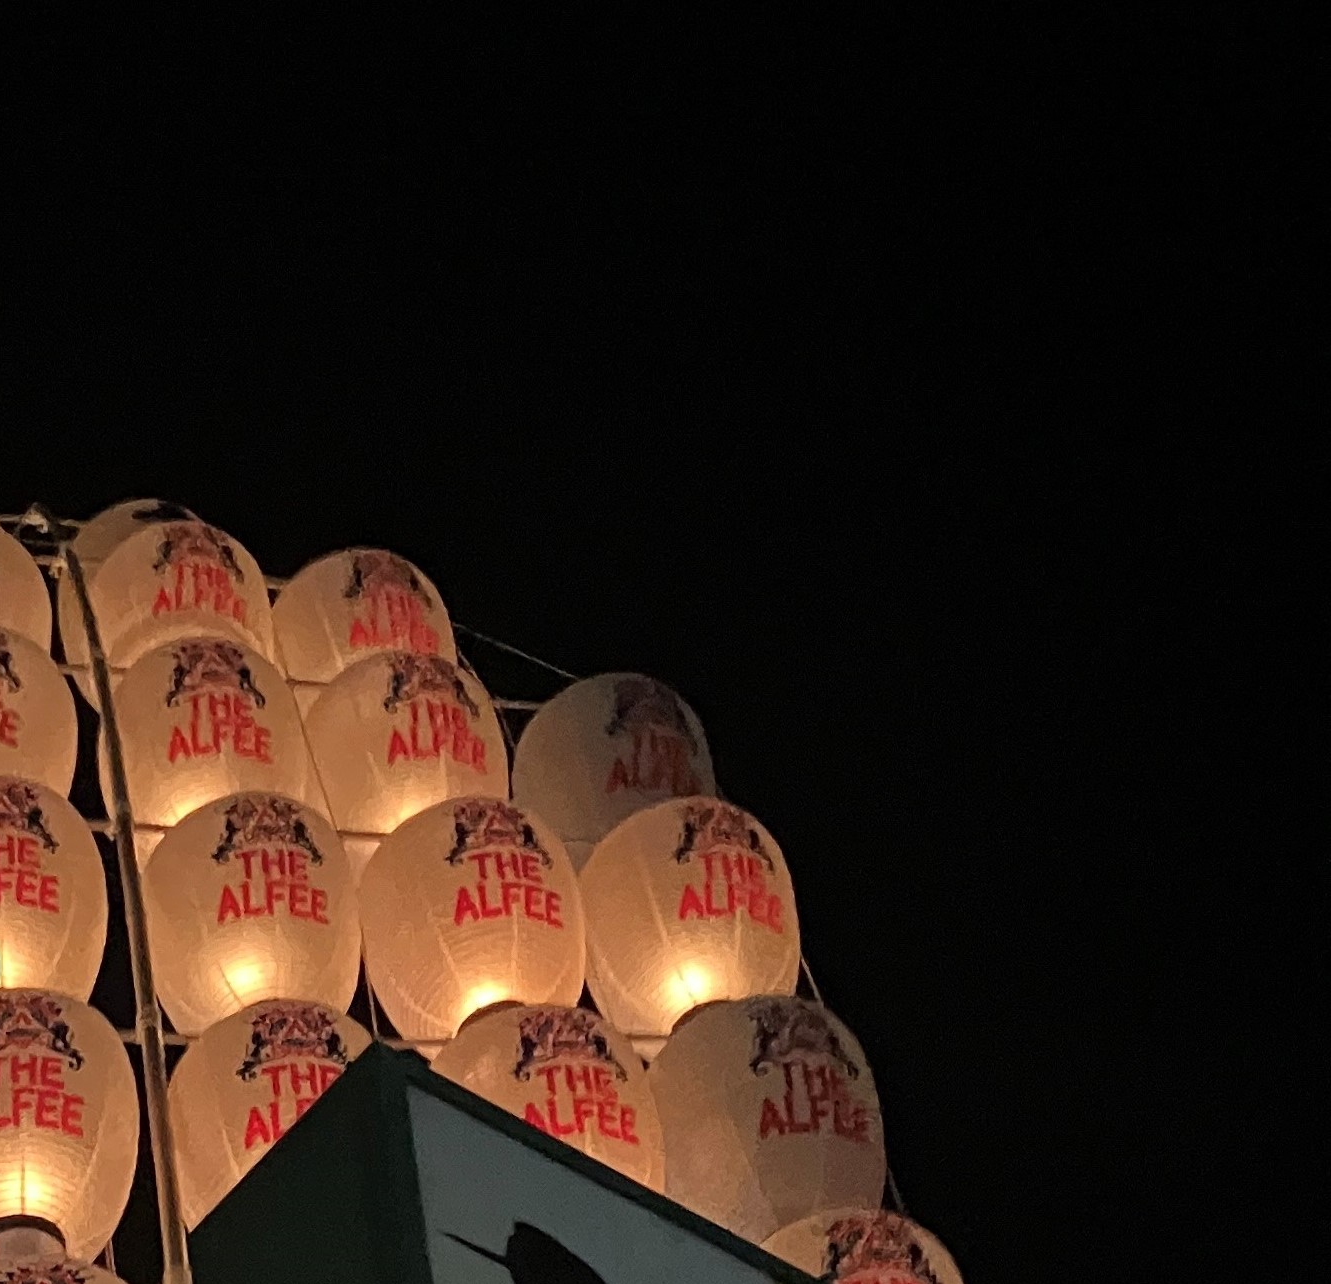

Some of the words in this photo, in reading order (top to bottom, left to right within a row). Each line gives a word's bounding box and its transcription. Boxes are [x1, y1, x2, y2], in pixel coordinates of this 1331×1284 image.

[184, 694, 255, 729] THE
[170, 724, 273, 765] ALFEE
[235, 849, 309, 883] THE
[470, 851, 543, 885] THE
[698, 851, 766, 887] THE
[217, 880, 329, 926] ALFEE
[453, 881, 564, 930] ALFEE
[677, 882, 784, 935] ALFEE
[536, 1064, 617, 1102] THE
